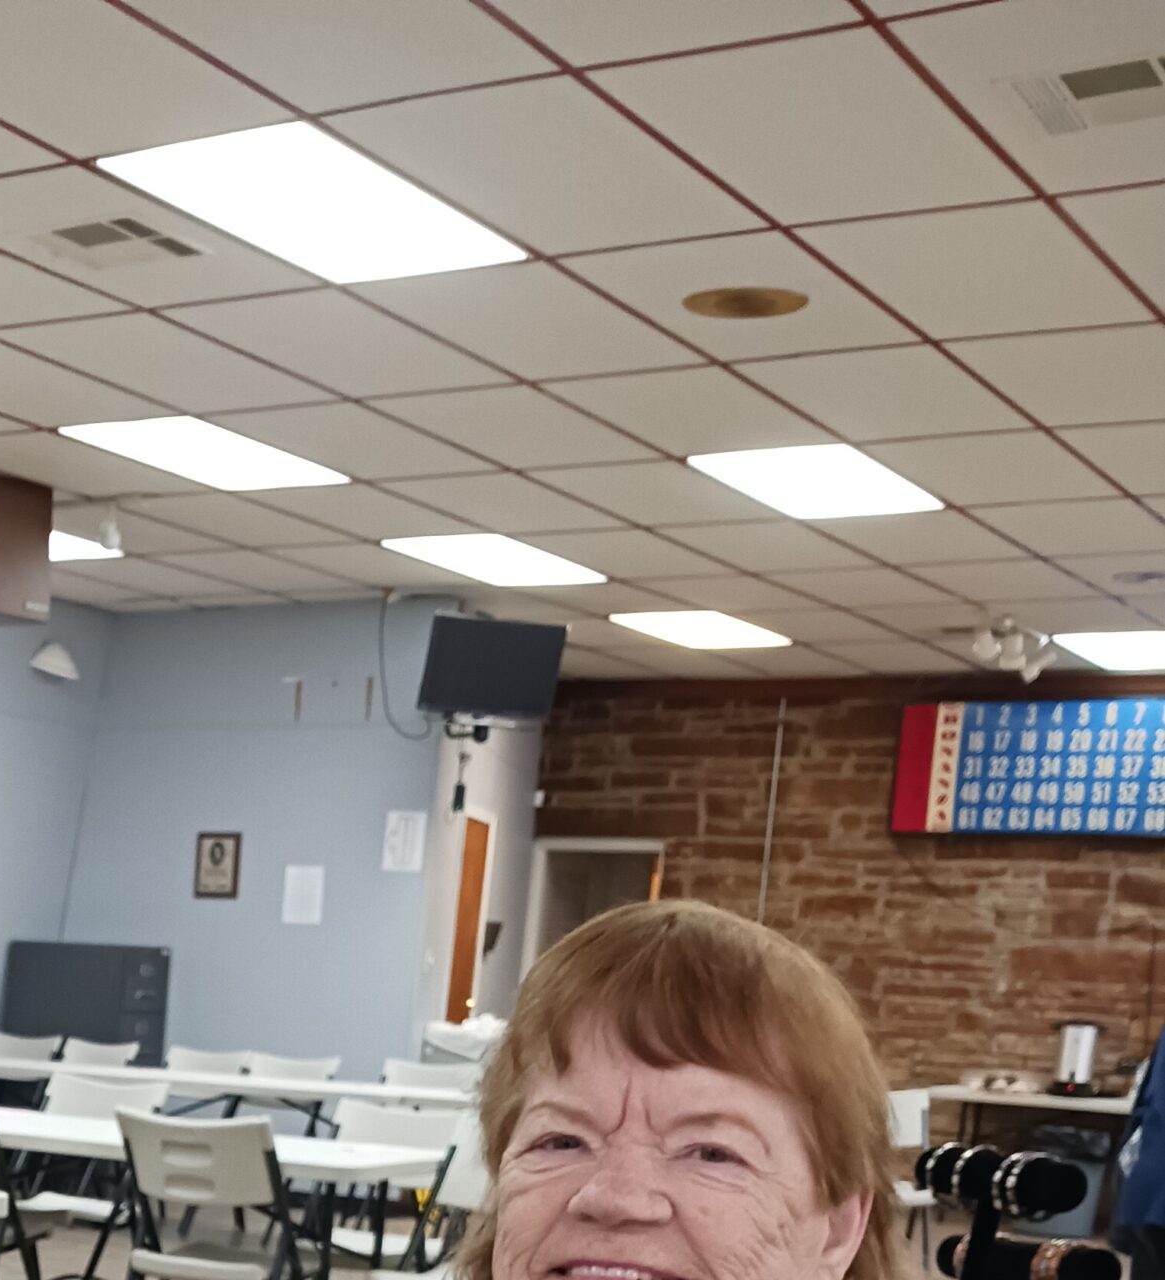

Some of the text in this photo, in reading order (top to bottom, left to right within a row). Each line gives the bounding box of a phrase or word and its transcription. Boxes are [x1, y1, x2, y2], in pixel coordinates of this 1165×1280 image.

[975, 704, 985, 727] 1
[998, 703, 1012, 727] 2
[1024, 702, 1038, 727] 3
[1051, 702, 1064, 726] 4
[1134, 701, 1147, 725] 7
[993, 730, 1012, 753] 17
[1068, 728, 1093, 752] 20
[1096, 728, 1119, 752] 21
[1122, 728, 1147, 752] 22
[962, 755, 983, 779] 31
[987, 755, 1010, 779] 32
[1013, 755, 1036, 779] 33
[1039, 755, 1061, 779] 34
[1066, 754, 1088, 778] 35
[1120, 754, 1144, 778] 37
[984, 781, 1008, 803] 47
[1091, 781, 1112, 805] 51
[1117, 781, 1140, 805] 52
[957, 806, 978, 830] 61
[982, 806, 1004, 830] 62
[1007, 806, 1030, 830] 63
[1032, 806, 1056, 831] 64
[1060, 806, 1082, 831] 65
[1114, 807, 1137, 832] 67
